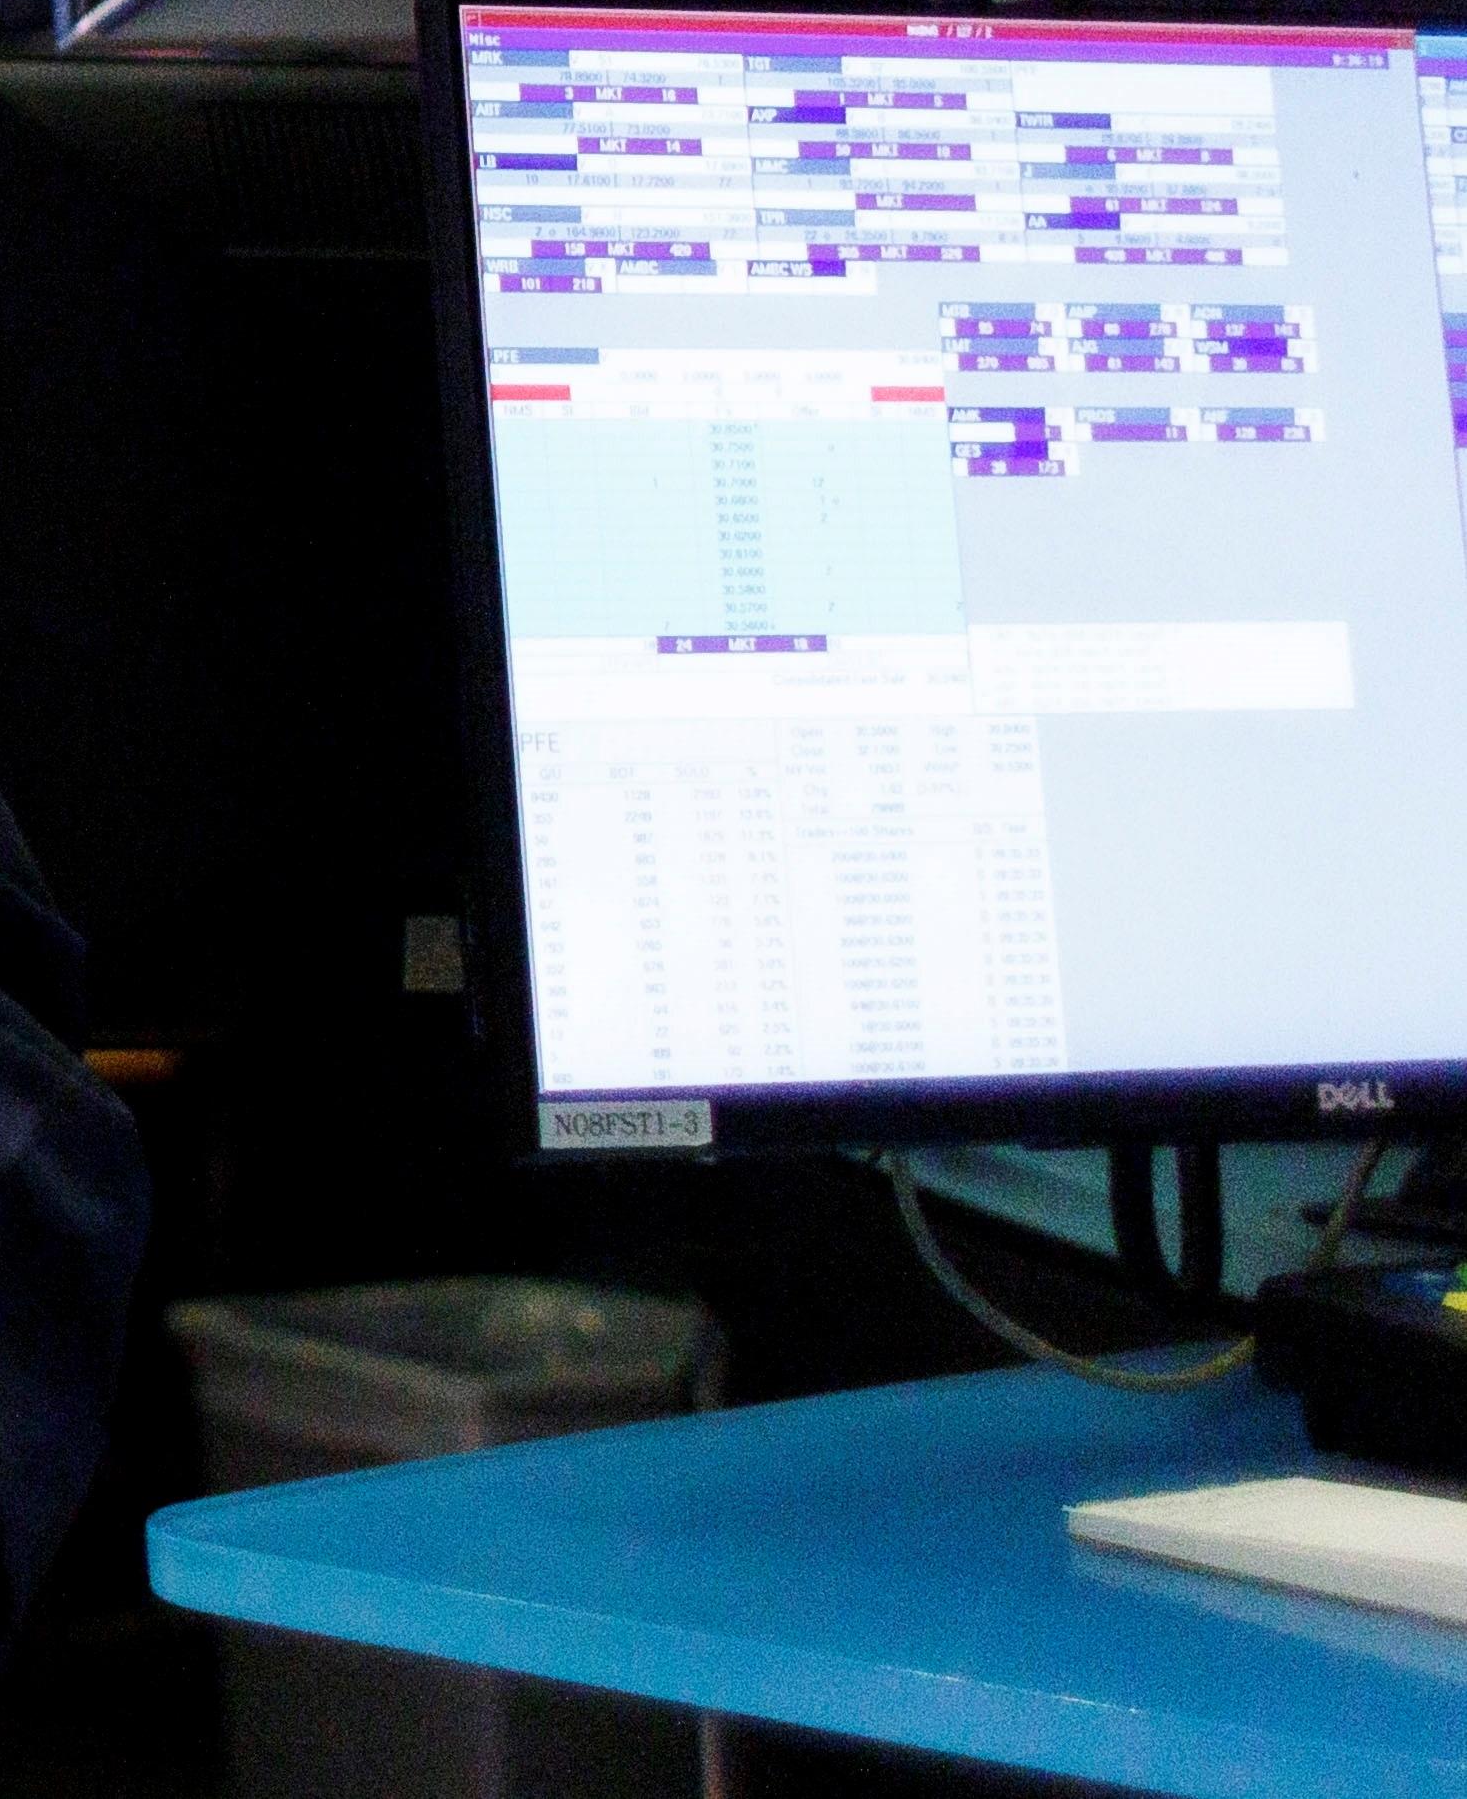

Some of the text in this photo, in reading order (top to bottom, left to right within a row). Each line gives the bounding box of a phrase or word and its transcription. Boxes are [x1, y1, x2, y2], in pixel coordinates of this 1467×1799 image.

[595, 88, 622, 100] MKT
[867, 94, 894, 105] MKT
[600, 140, 626, 151] MKT
[872, 145, 898, 156] MKT
[876, 196, 903, 208] MKT
[608, 244, 634, 255] MKT
[881, 249, 907, 260] MKT
[493, 349, 520, 365] PFE
[729, 638, 755, 653] MKT
[520, 731, 561, 754] PFE
[1318, 1082, 1396, 1112] DELL
